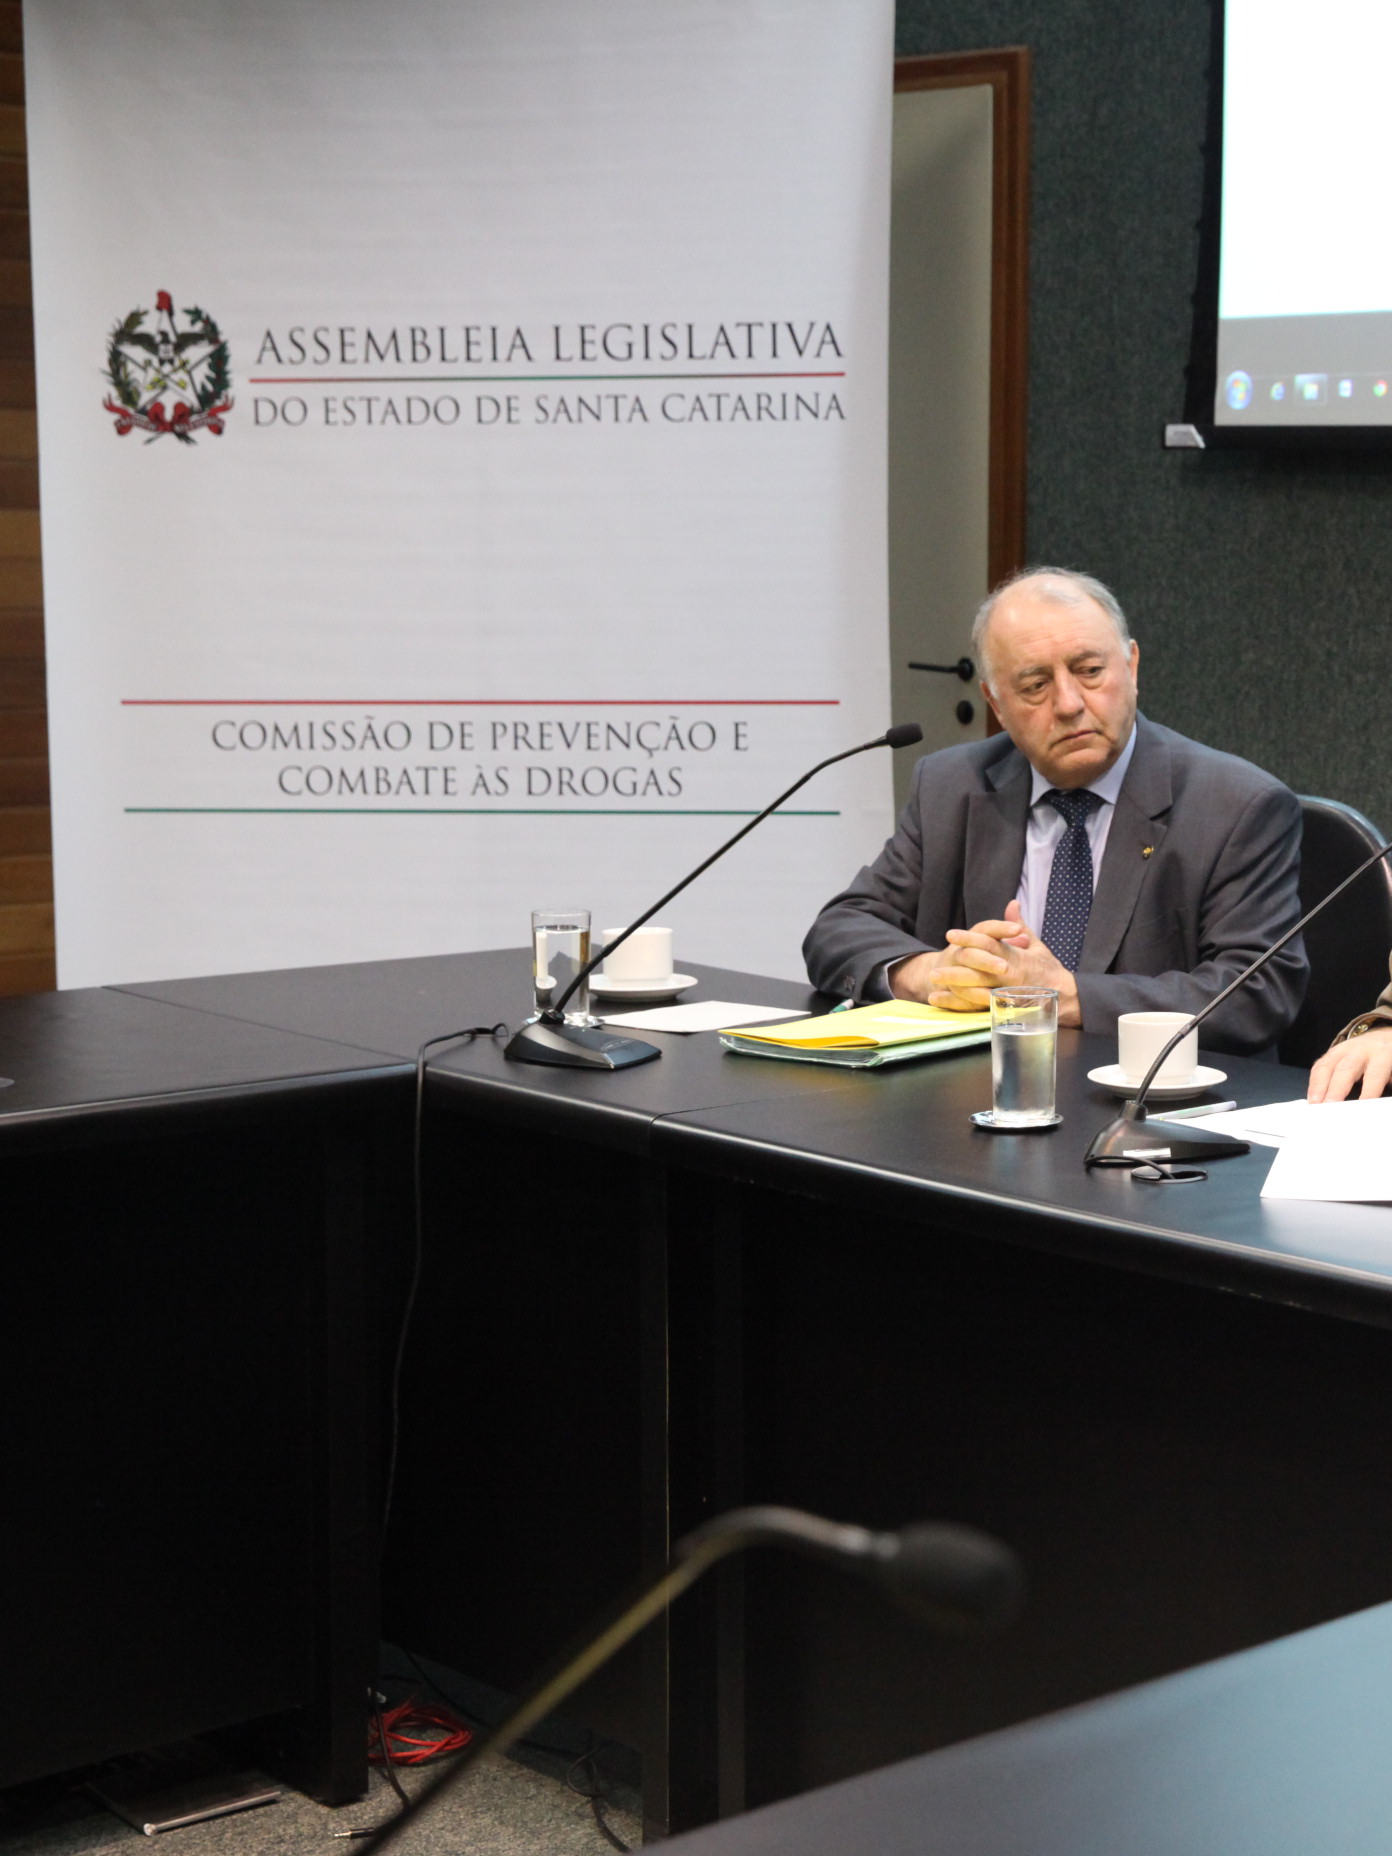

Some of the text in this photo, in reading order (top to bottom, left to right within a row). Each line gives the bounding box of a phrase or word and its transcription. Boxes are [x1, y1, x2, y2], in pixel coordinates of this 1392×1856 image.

[255, 320, 843, 366] ASSEMBLEIA LEGISLATIVA
[253, 397, 309, 427] DO
[323, 396, 461, 426] ESTADO
[475, 395, 519, 425] DE
[535, 394, 649, 424] SANTA
[660, 392, 846, 423] CATARINA
[211, 715, 749, 759] COMISSÃO DE PREVENÇÃO E
[277, 764, 683, 797] COMBATE ÀS DROGAS
